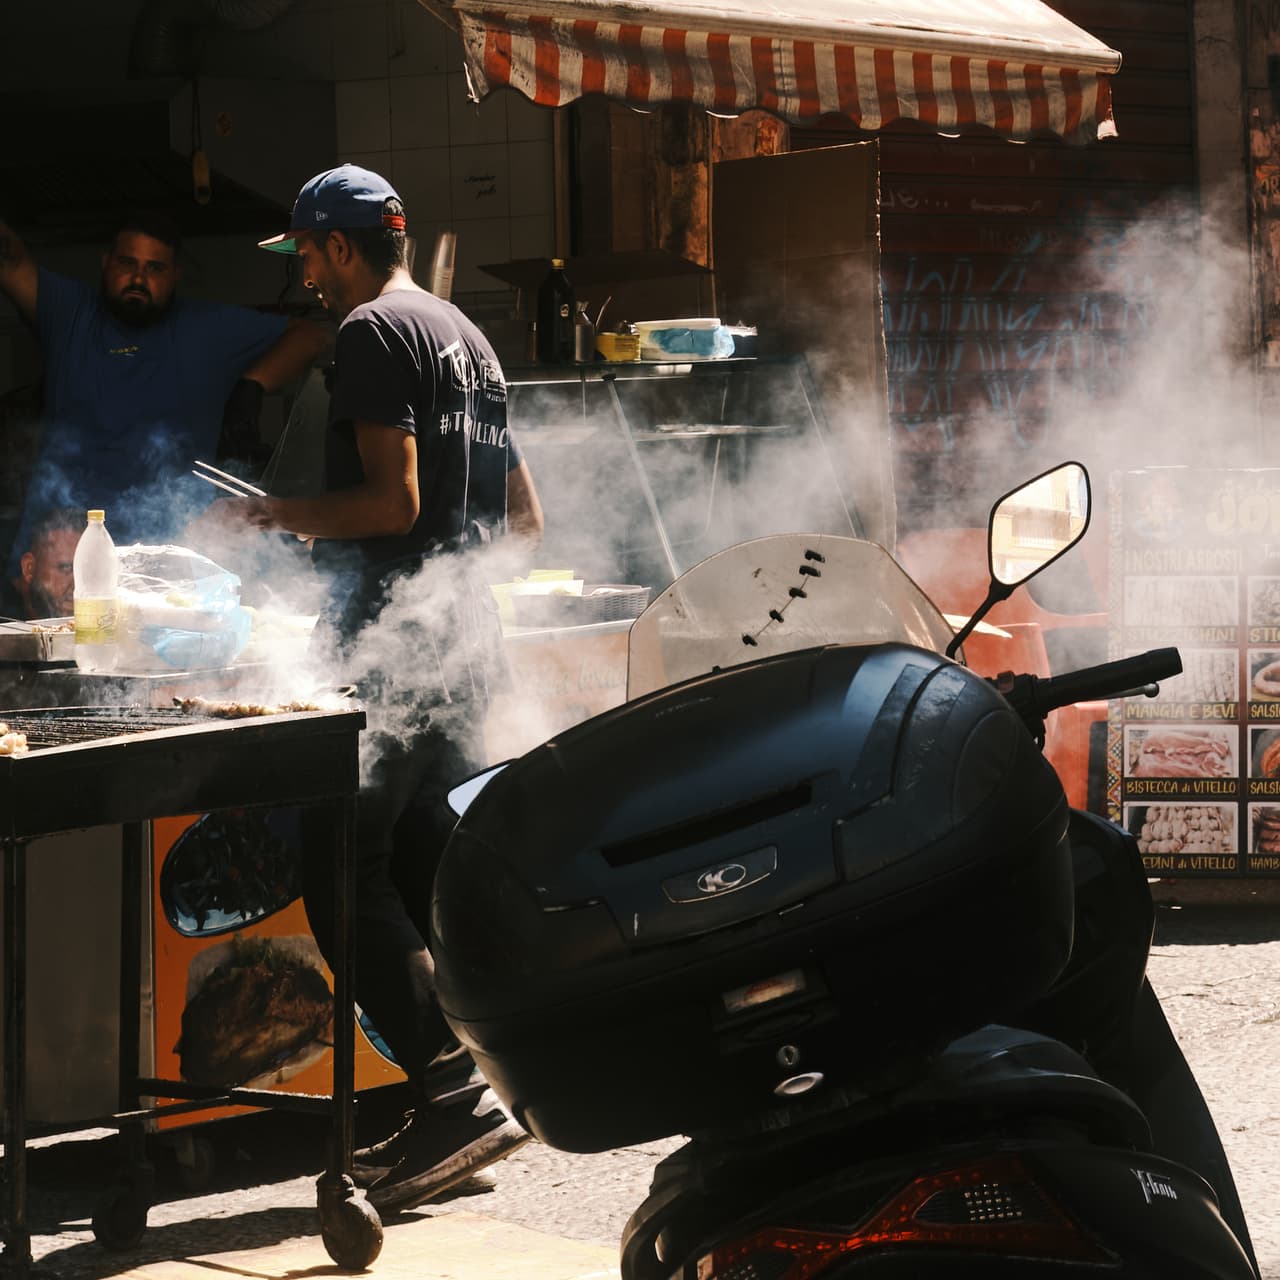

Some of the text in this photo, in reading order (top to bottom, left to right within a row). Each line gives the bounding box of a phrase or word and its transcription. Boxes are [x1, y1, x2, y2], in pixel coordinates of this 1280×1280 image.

[1127, 703, 1236, 719] MANGIA E BEVI
[1126, 781, 1237, 795] BISTECCA di VITELLO
[1144, 857, 1175, 871] EDINI
[1191, 856, 1237, 871] VITELLO
